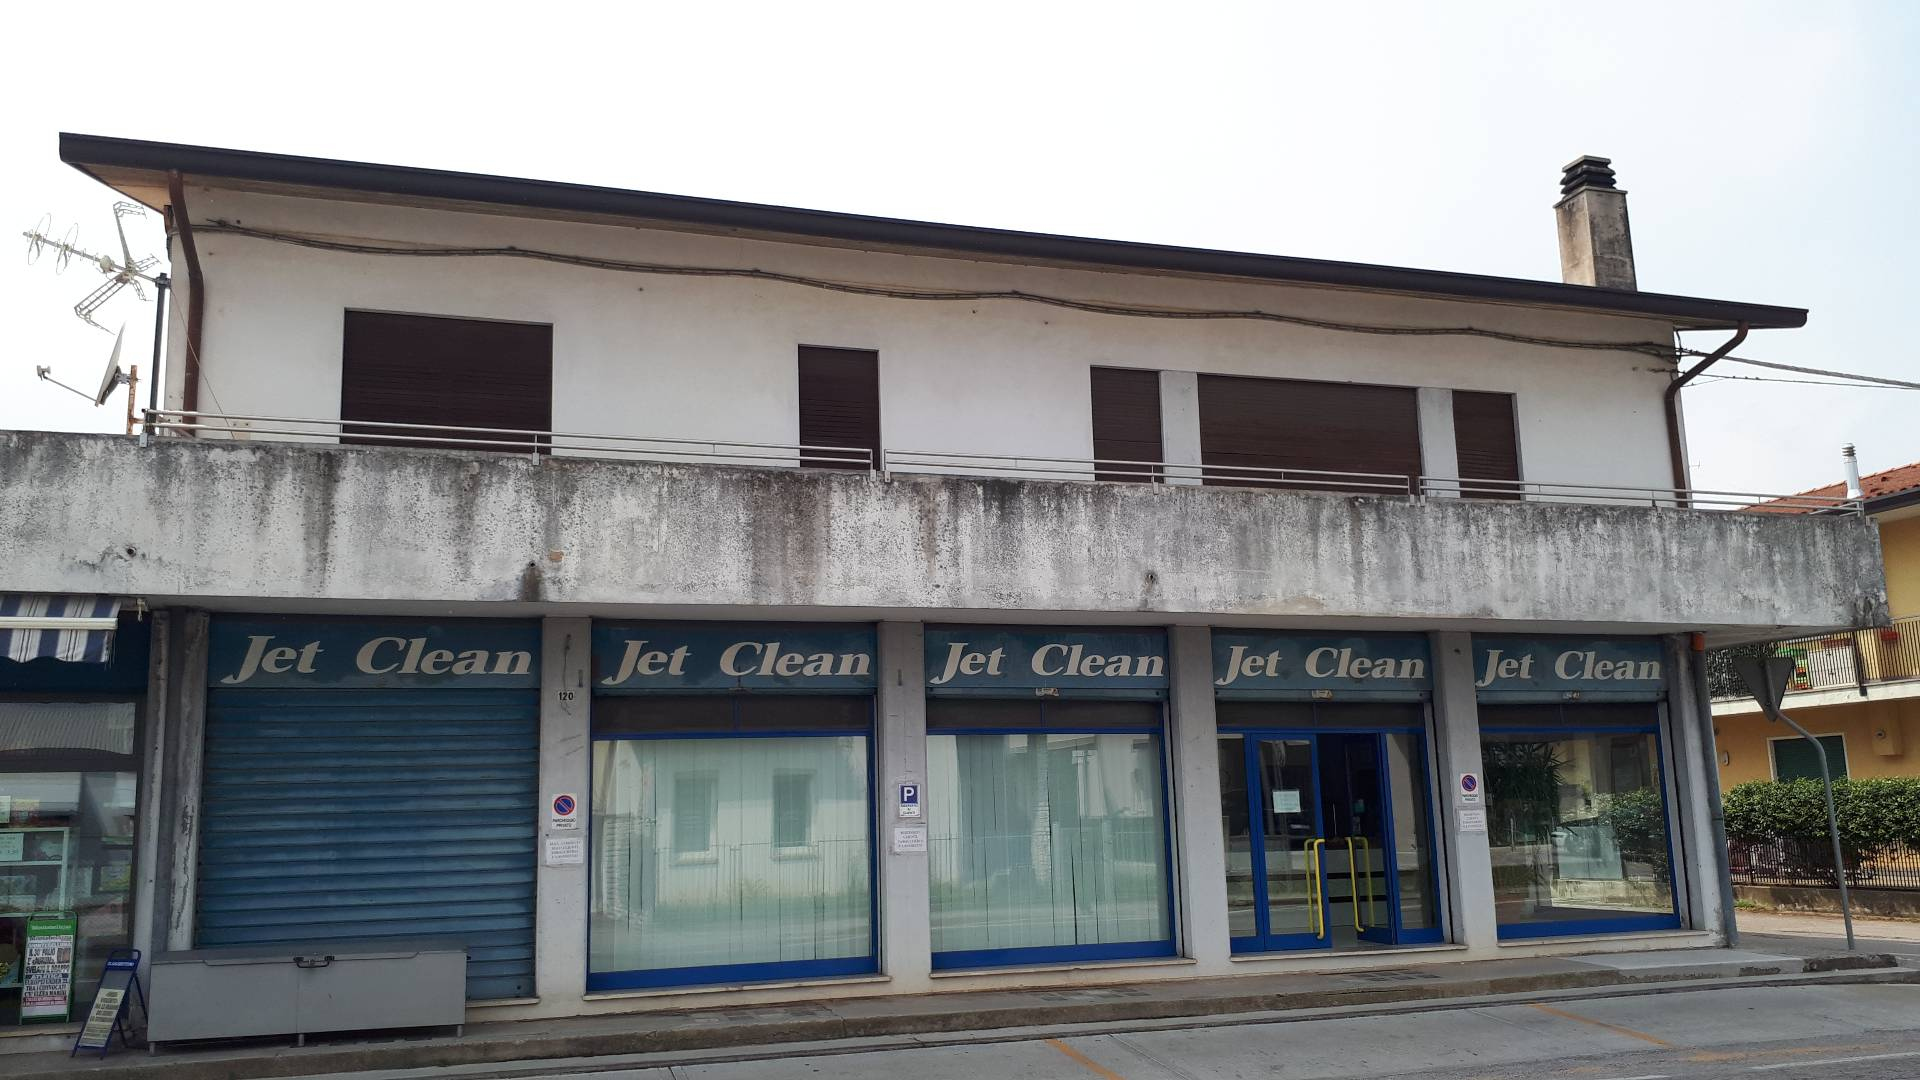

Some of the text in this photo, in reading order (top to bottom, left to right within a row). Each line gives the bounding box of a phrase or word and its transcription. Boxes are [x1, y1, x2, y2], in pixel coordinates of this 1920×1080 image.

[221, 635, 532, 684] Jet Clean
[602, 639, 870, 685] Jet Clean
[930, 642, 1164, 685] Jet Clean
[1213, 645, 1426, 686] Jet Clean
[1474, 649, 1662, 688] Jet Clean
[559, 691, 574, 701] 120
[903, 787, 915, 802] P
